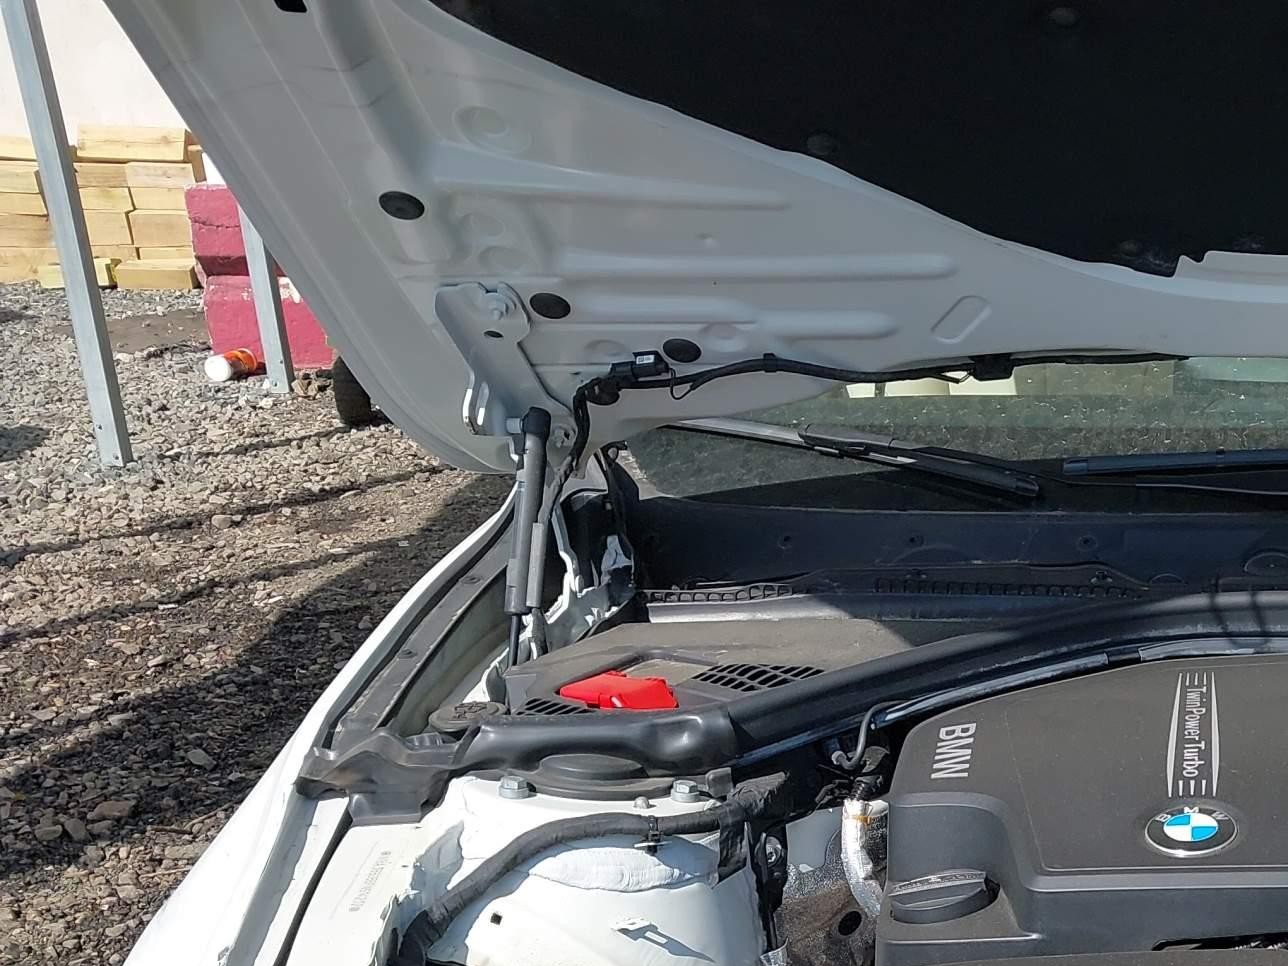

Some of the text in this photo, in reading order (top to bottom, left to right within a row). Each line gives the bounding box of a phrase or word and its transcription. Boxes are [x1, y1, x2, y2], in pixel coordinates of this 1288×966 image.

[931, 722, 976, 779] BMW
[1182, 686, 1207, 778] TwinPower Turbo
[1155, 806, 1229, 823] BMW
